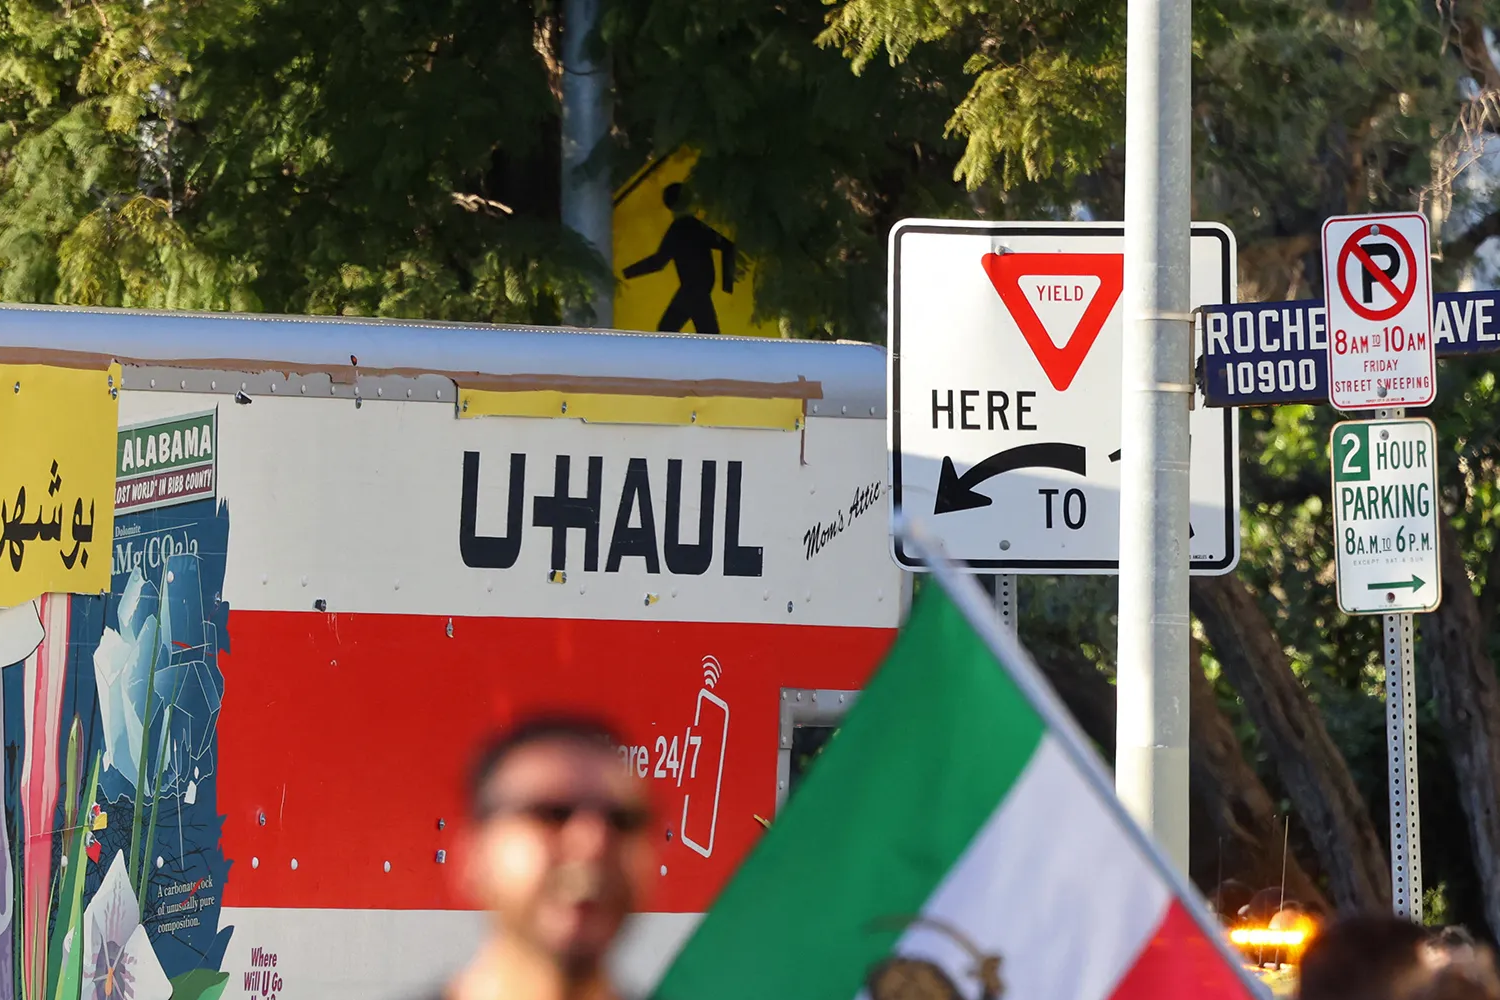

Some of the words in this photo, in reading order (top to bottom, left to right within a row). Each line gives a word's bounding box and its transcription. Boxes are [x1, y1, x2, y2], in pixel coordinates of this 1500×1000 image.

[1036, 286, 1084, 301] YIELD
[1207, 307, 1327, 355] ROCHE
[1372, 335, 1380, 346] TO
[1226, 359, 1317, 395] 10900
[1364, 359, 1398, 372] FRIDAY
[1335, 379, 1372, 393] STREET
[1377, 376, 1429, 390] SWEEPING
[931, 389, 1037, 430] HERE
[122, 424, 212, 472] ALABAMA
[1341, 433, 1361, 473] 2
[1377, 440, 1427, 470] HOUR
[159, 477, 166, 496] IN
[168, 475, 183, 495] BIBB
[185, 469, 212, 490] COUNTY
[459, 451, 764, 577] U-HAUL
[1038, 488, 1087, 530] TO
[1342, 483, 1429, 521] PARKING
[115, 523, 141, 537] Dolomite
[803, 509, 844, 561] Mom's
[848, 480, 881, 526] Attic
[654, 727, 702, 787] 24/7
[158, 885, 163, 897] A
[158, 902, 165, 916] of
[199, 896, 215, 911] pure
[158, 915, 200, 934] composition.
[251, 947, 277, 967] Where
[244, 972, 259, 991] Will
[262, 971, 270, 997] U
[272, 972, 283, 992] Go
